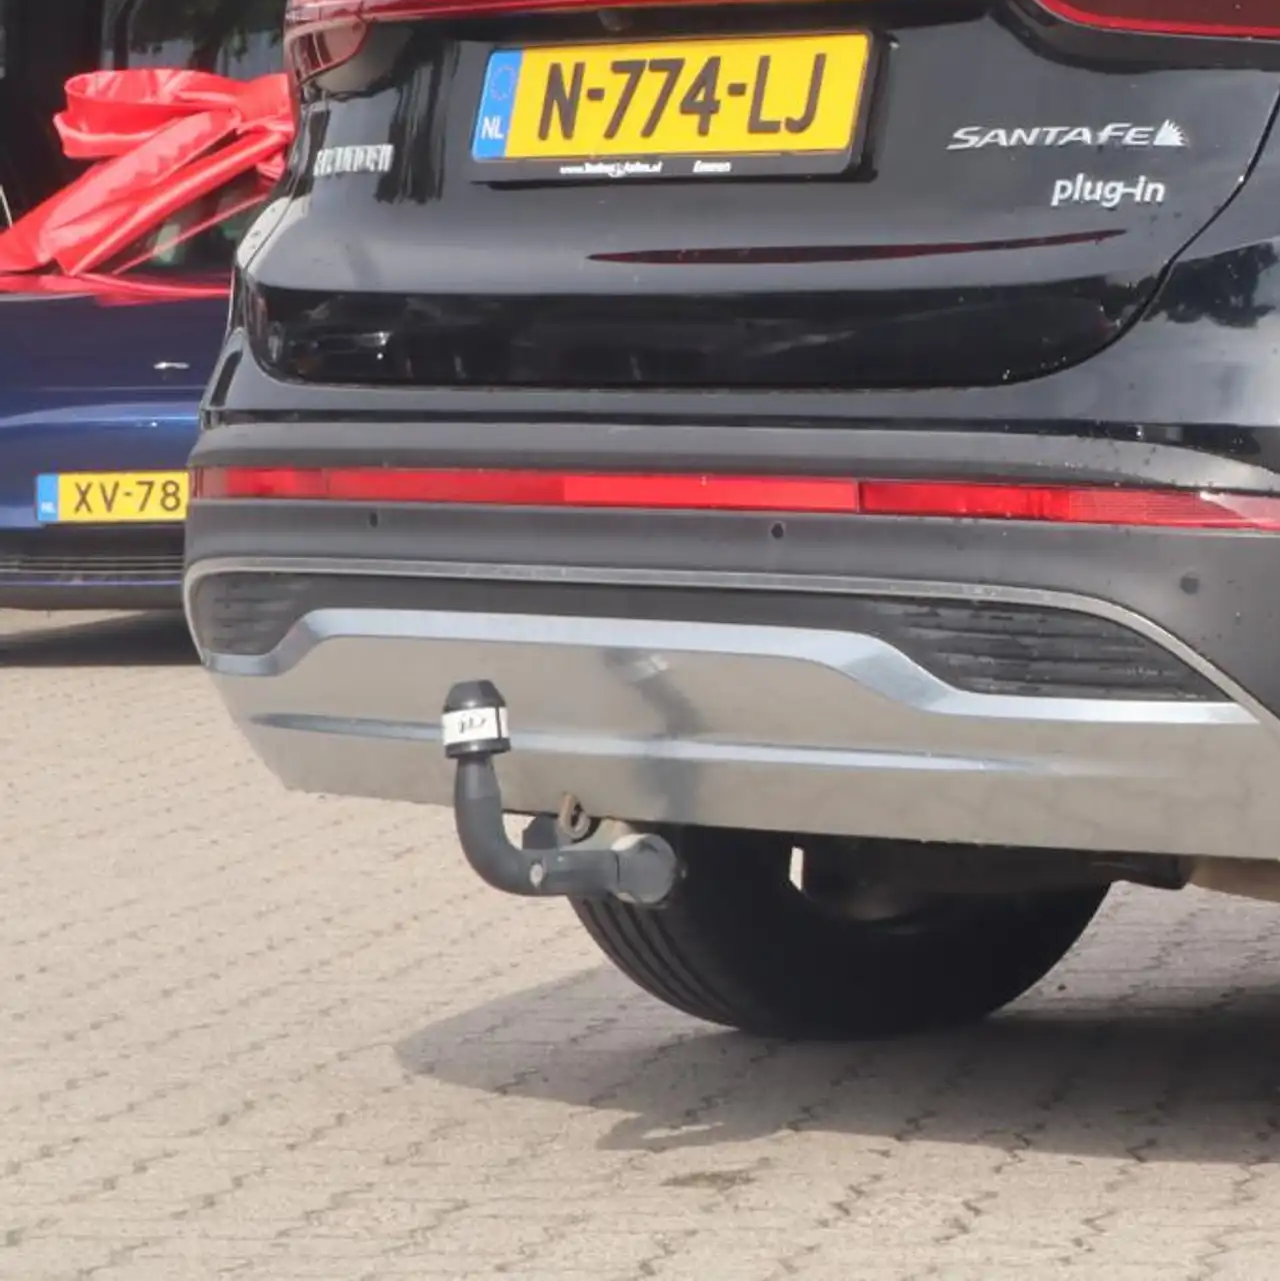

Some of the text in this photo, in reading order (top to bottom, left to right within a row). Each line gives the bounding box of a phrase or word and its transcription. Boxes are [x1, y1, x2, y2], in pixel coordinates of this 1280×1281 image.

[481, 52, 828, 141] NL N-774-LJ
[1050, 173, 1166, 208] plug-in
[74, 479, 182, 515] XV-78
